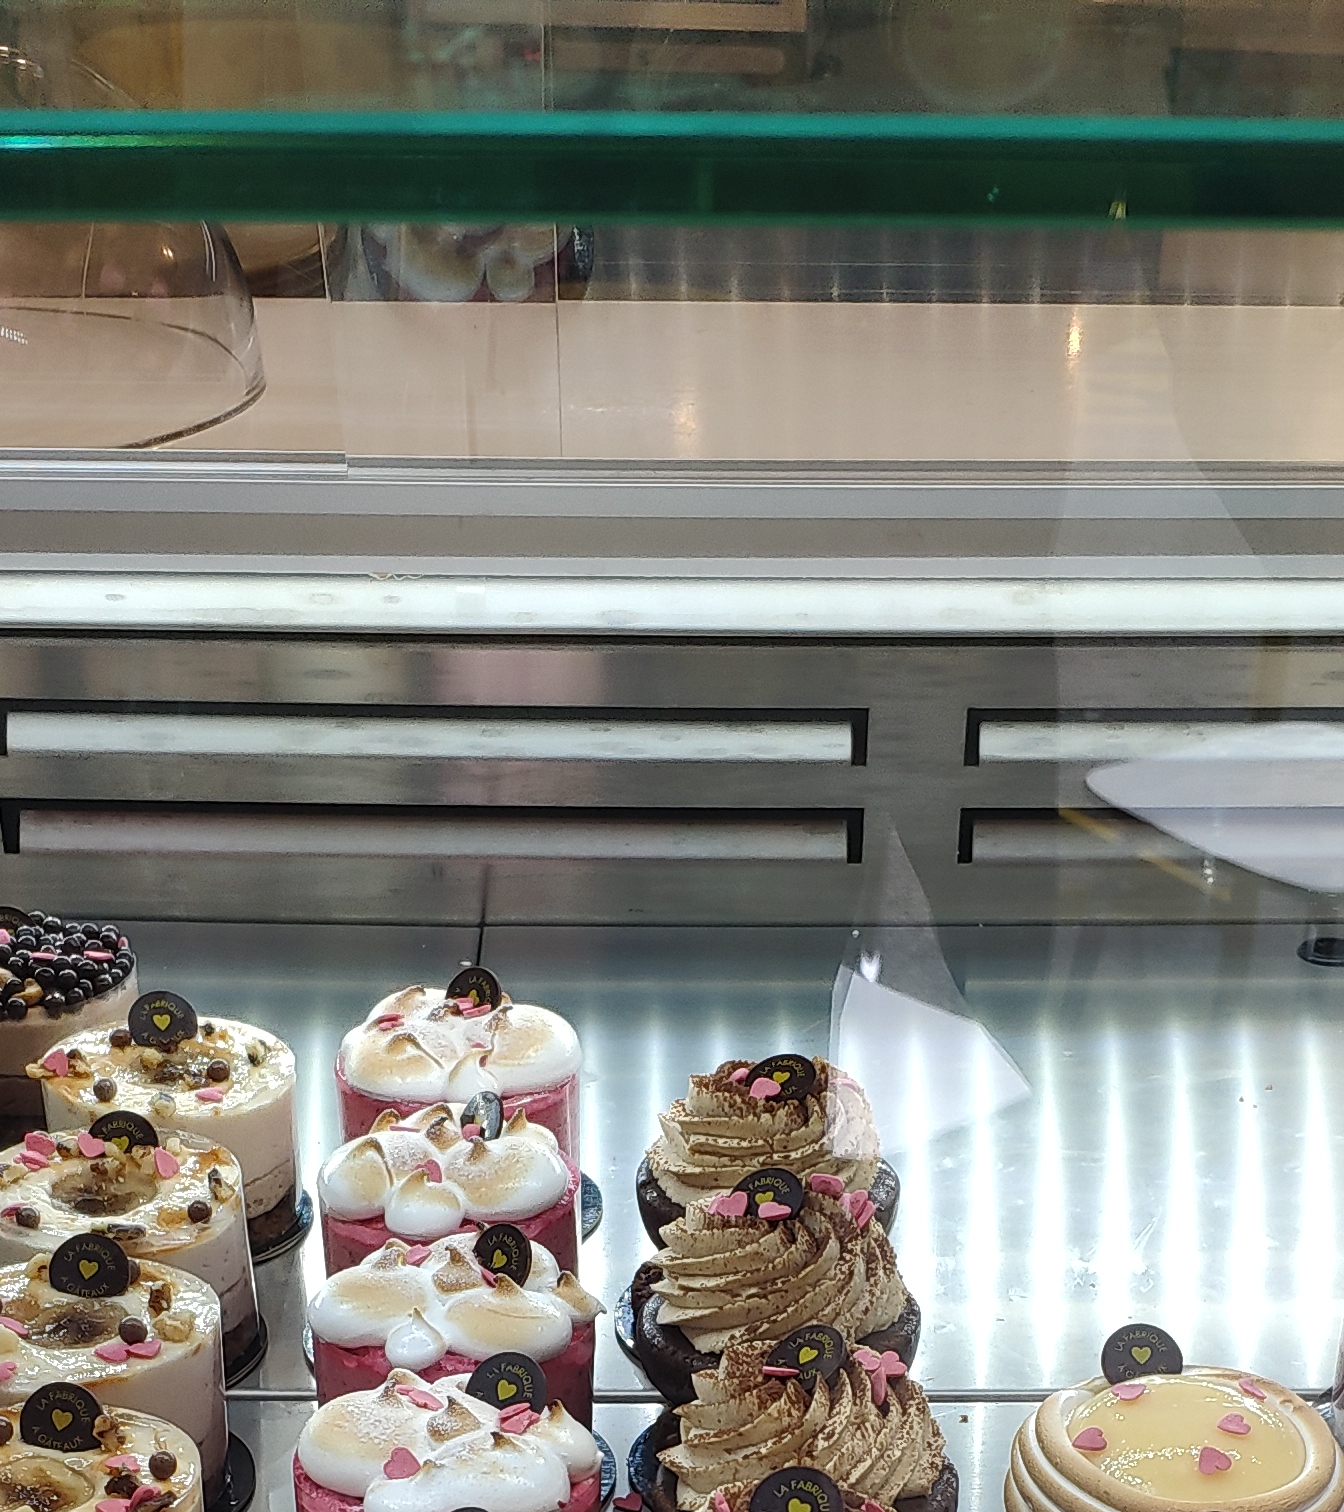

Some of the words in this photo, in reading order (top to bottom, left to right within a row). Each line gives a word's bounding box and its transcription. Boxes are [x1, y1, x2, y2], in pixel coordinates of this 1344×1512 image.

[75, 1242, 116, 1272] FABRIQUE
[48, 1389, 92, 1423] FABRIQUE
[773, 1484, 790, 1499] LA
